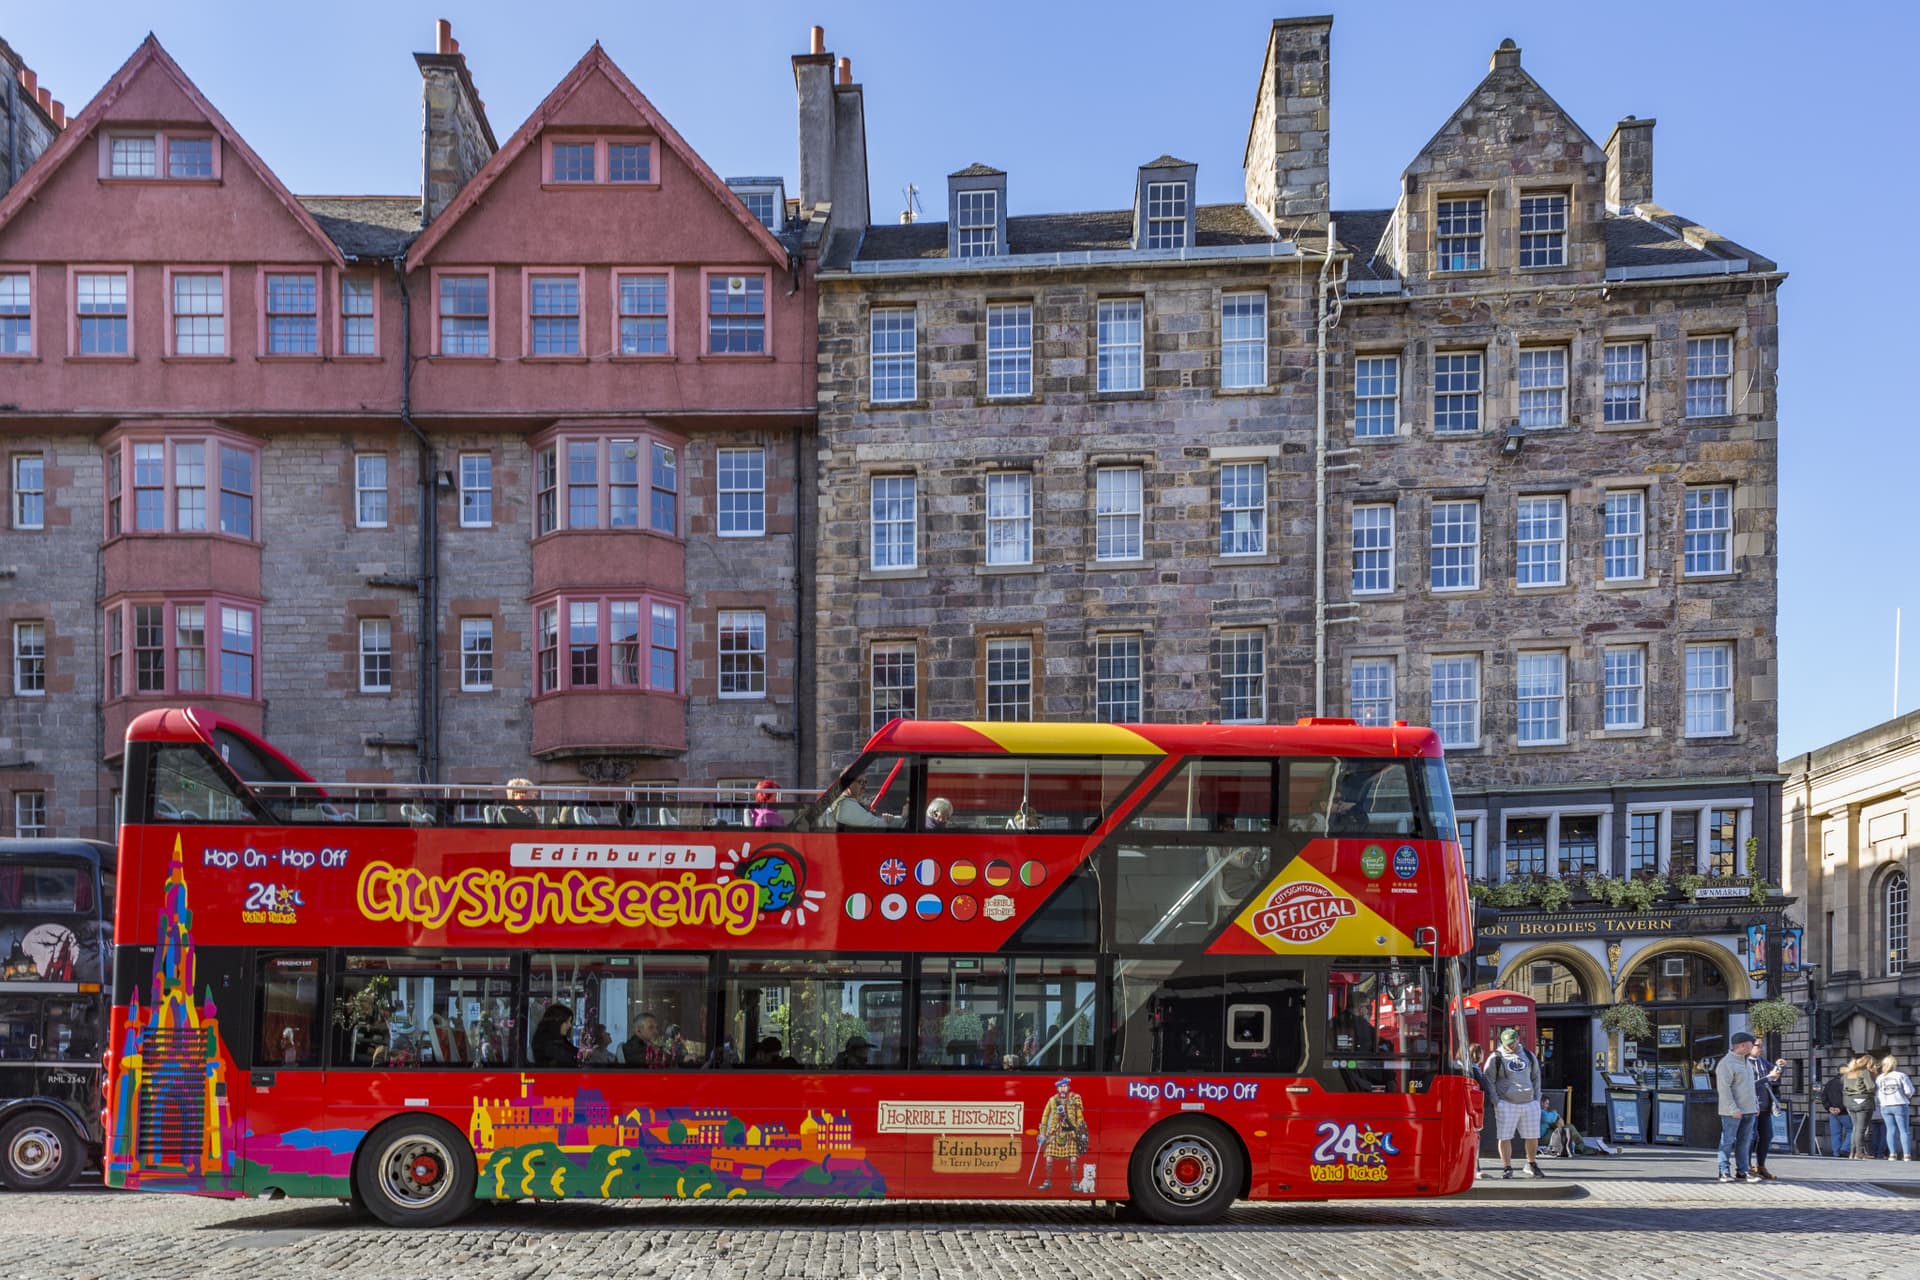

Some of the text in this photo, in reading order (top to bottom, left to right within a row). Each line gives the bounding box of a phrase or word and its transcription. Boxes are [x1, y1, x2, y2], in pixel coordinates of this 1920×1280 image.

[204, 849, 239, 868] Hop
[244, 848, 267, 867] On
[281, 849, 315, 868] Hop
[320, 848, 347, 867] Off
[529, 846, 698, 865] Edinburgh
[246, 882, 276, 911] 24
[358, 860, 760, 936] CitySightseeing
[1274, 885, 1328, 905] CITYSIGHTSEEING
[1263, 899, 1351, 931] OFFICIAL
[1604, 918, 1672, 932] TAVERN
[1291, 921, 1330, 940] TOUR
[48, 1075, 65, 1084] RML
[1129, 1082, 1160, 1101] Hop
[1164, 1081, 1185, 1099] On
[1198, 1082, 1229, 1101] Hop
[1233, 1082, 1258, 1099] Off
[887, 1109, 1015, 1126] HORRIBLE HISTORIES
[937, 1140, 1017, 1161] Edinburgh
[1314, 1122, 1358, 1163] 24
[950, 1157, 972, 1169] Terry
[975, 1158, 1001, 1169] Deary
[1311, 1163, 1388, 1182] Valid Ticket
